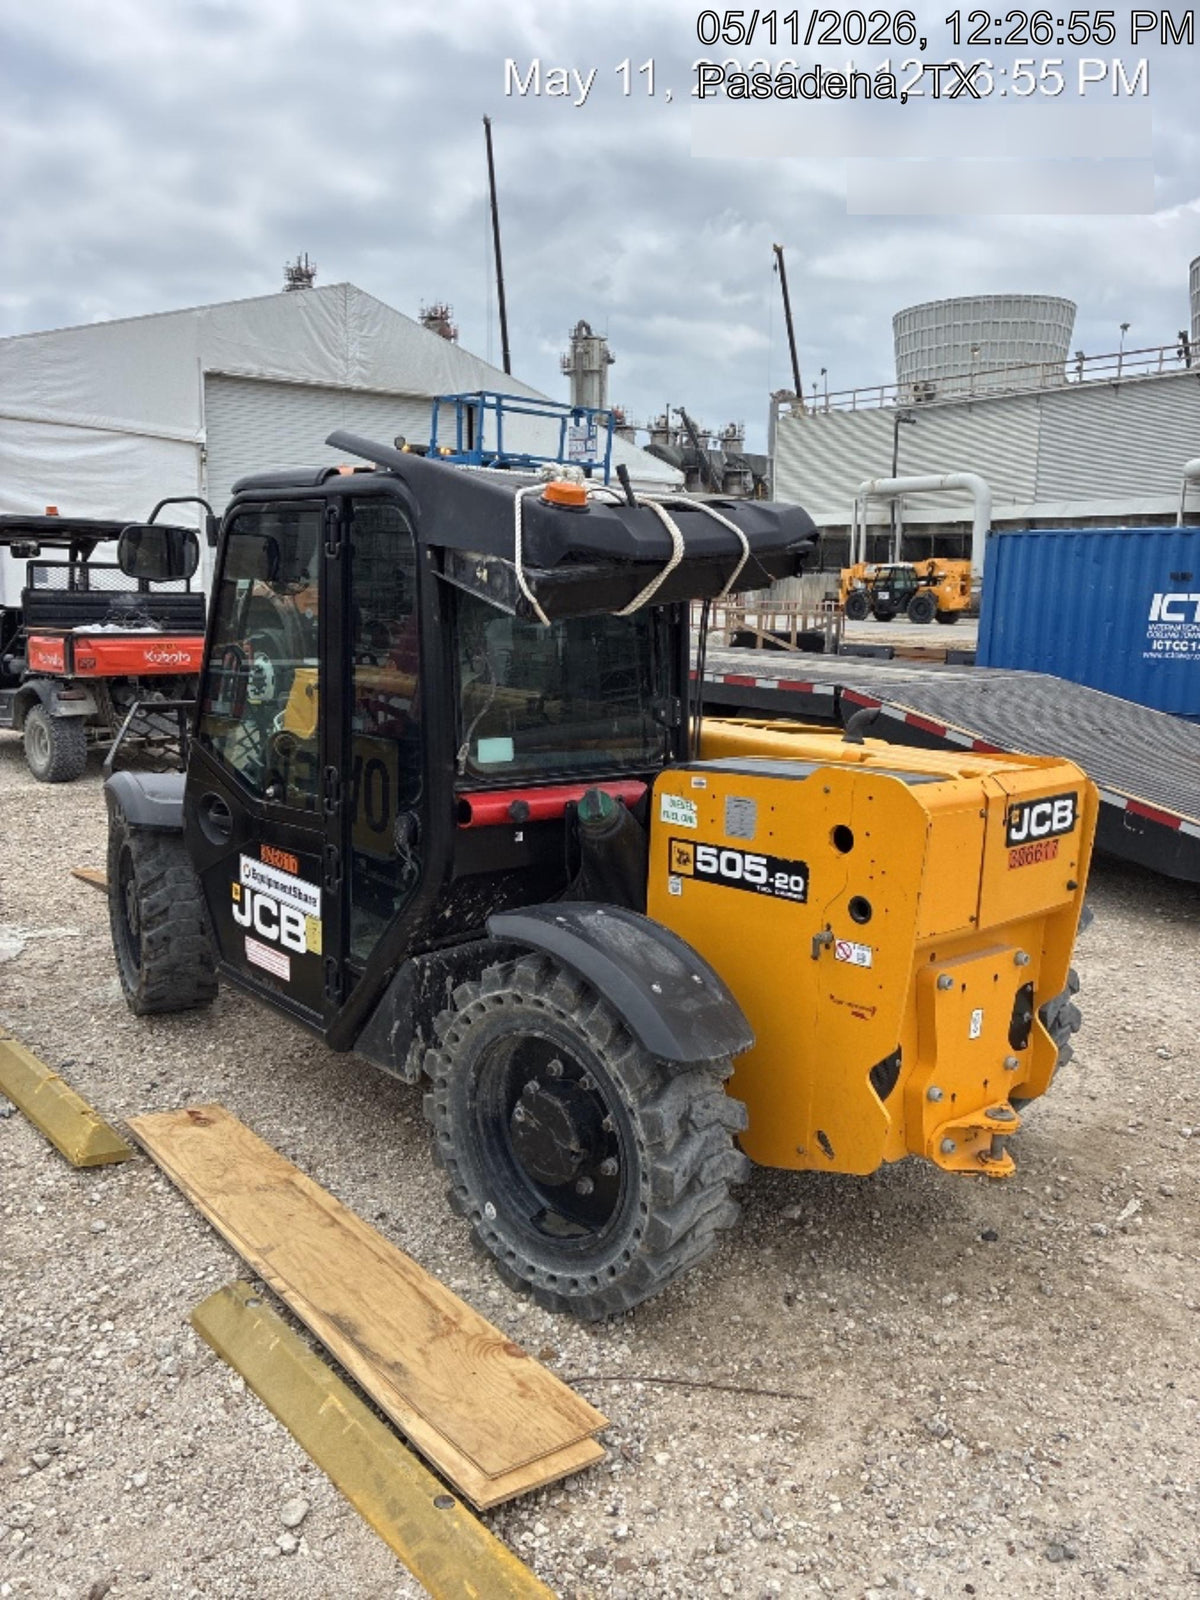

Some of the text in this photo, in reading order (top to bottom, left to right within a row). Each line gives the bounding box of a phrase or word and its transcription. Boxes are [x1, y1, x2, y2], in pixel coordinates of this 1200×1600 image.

[143, 650, 191, 664] Kubota
[1010, 799, 1073, 840] JCB
[231, 887, 308, 954] JCB
